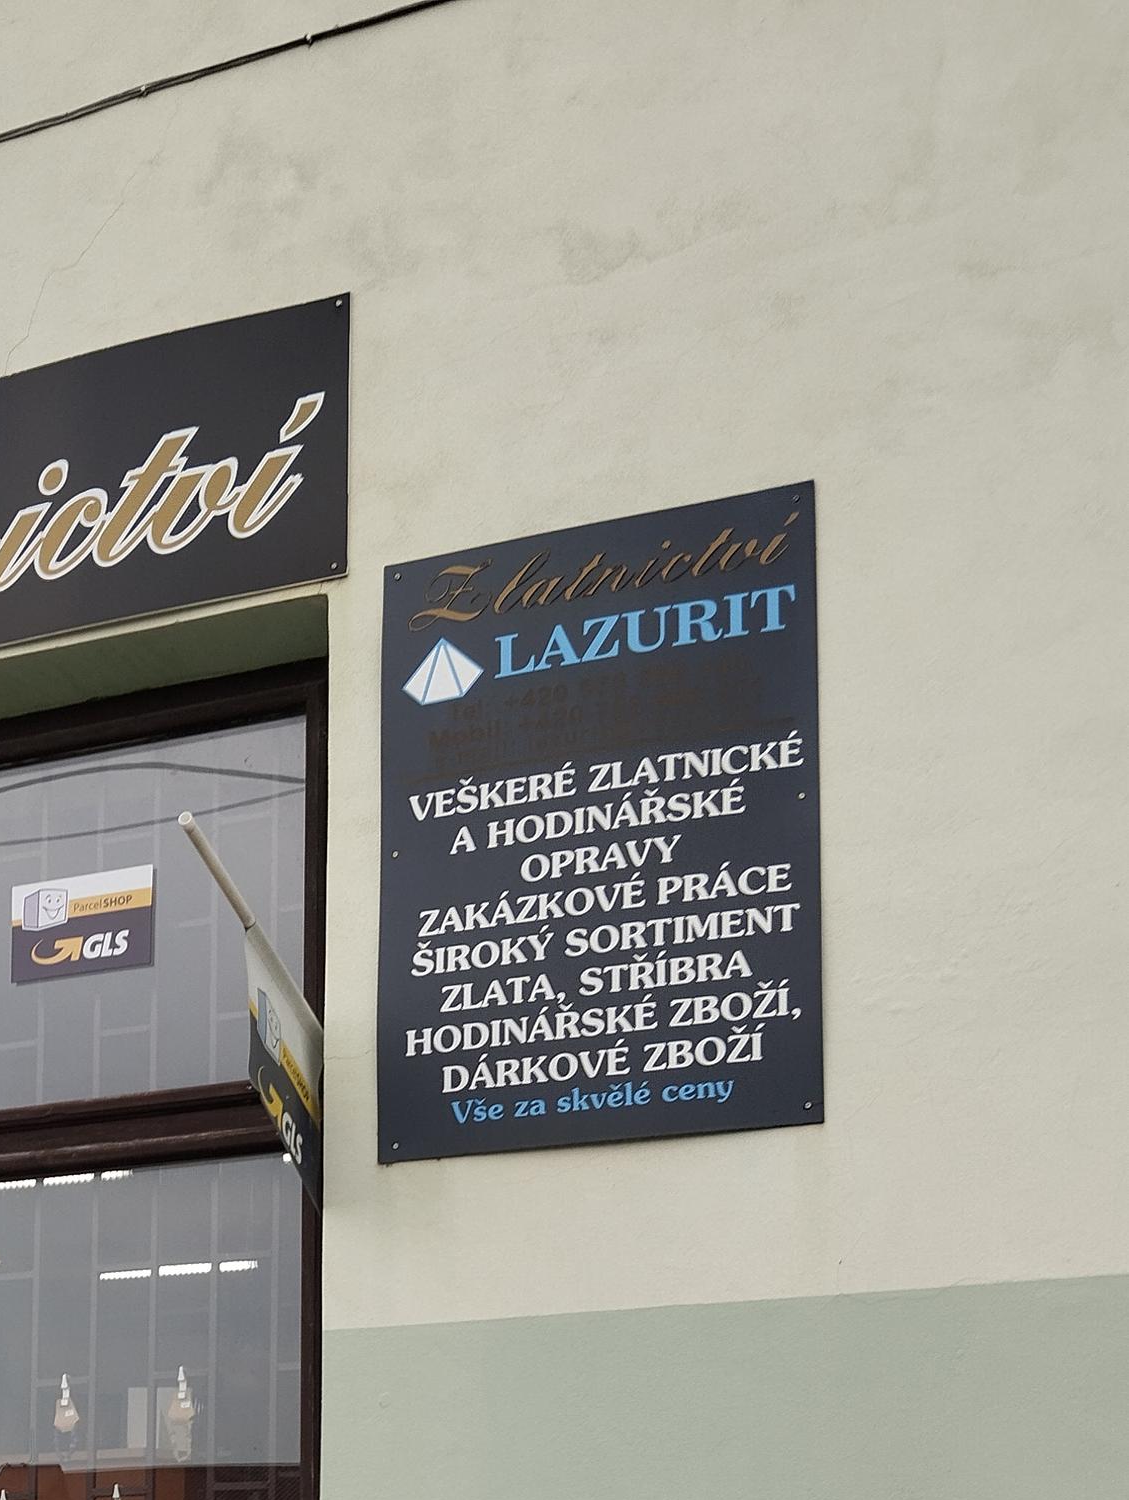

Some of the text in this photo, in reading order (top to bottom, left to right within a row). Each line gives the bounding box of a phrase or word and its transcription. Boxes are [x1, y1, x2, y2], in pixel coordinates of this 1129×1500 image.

[408, 511, 800, 633] Zlatnictví
[493, 584, 797, 680] LAZURIT
[409, 762, 576, 822] VEŠKERÉ
[587, 730, 805, 793] ZLATNICKÉ
[449, 785, 747, 856] A HODINÁŘSKÉ
[519, 833, 683, 884] OPRAVY
[73, 894, 132, 912] ParcelSHOP
[417, 862, 793, 938] ZAKÁZKOVÉ PRÁCE
[82, 929, 130, 960] GLS
[410, 902, 801, 978] ŠIROKÝ SORTIMENT
[405, 978, 802, 1057] HODINÁŘSKÉ ZBOŽÍ,
[439, 950, 754, 1014] ZLATA, STŘÍBRA
[441, 1022, 766, 1094] DÁRKOVÉ ZBOŽÍ
[451, 1078, 735, 1126] Vše za skvělé ceny
